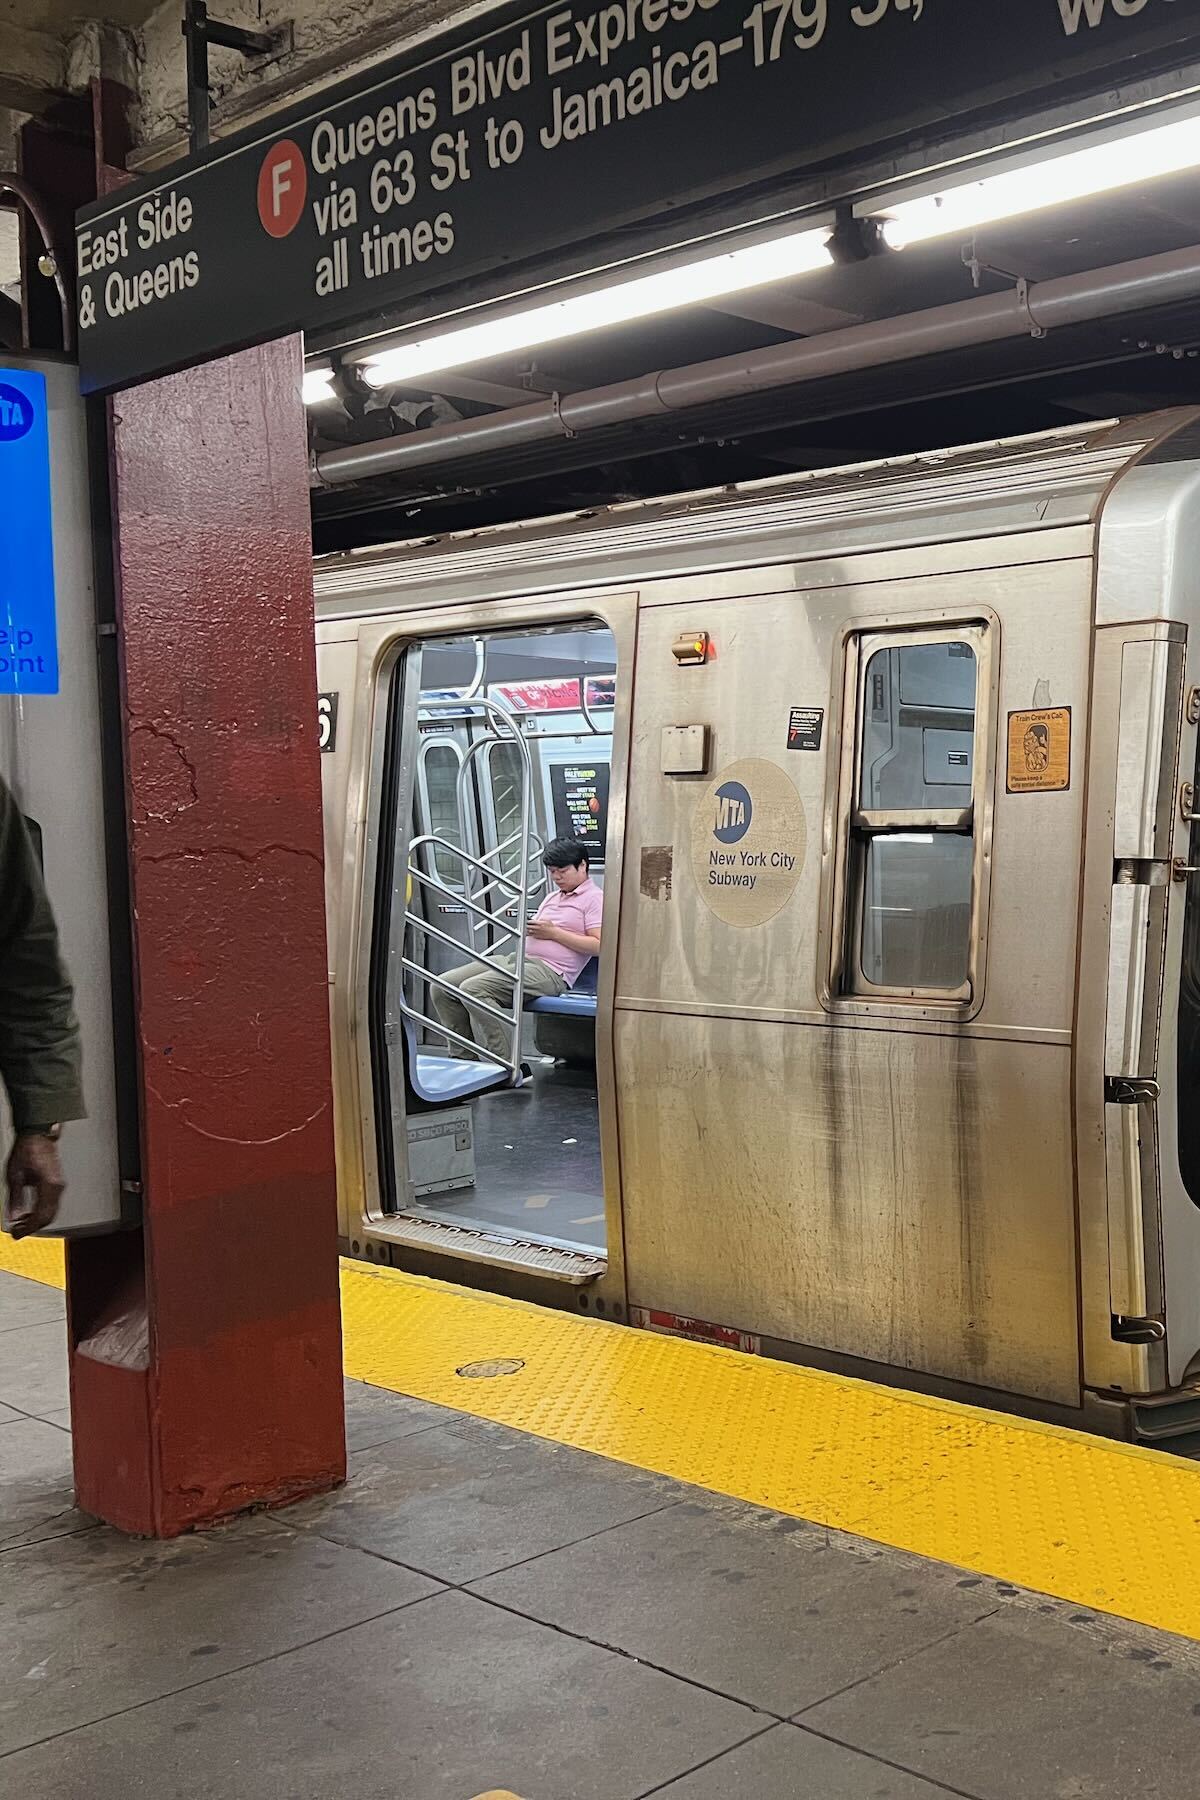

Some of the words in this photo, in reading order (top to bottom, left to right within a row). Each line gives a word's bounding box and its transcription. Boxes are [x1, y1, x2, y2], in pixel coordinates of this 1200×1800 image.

[311, 87, 437, 174] Queens
[451, 29, 531, 117] Blvd
[547, 0, 719, 75] Expre
[272, 159, 291, 217] F
[313, 180, 358, 236] via
[370, 150, 417, 214] 63
[430, 129, 471, 191] St
[485, 117, 524, 169] to
[77, 216, 128, 277] East
[137, 190, 193, 250] Side
[315, 237, 349, 296] all
[360, 212, 455, 279] times
[79, 284, 97, 329] &
[105, 251, 200, 318] Queens
[0, 398, 24, 426] TA
[0, 627, 33, 650] elp
[0, 655, 44, 673] oint
[713, 794, 745, 831] MTA
[708, 870, 757, 890] Subway
[709, 850, 736, 866] New
[740, 851, 767, 867] York
[770, 852, 796, 871] City
